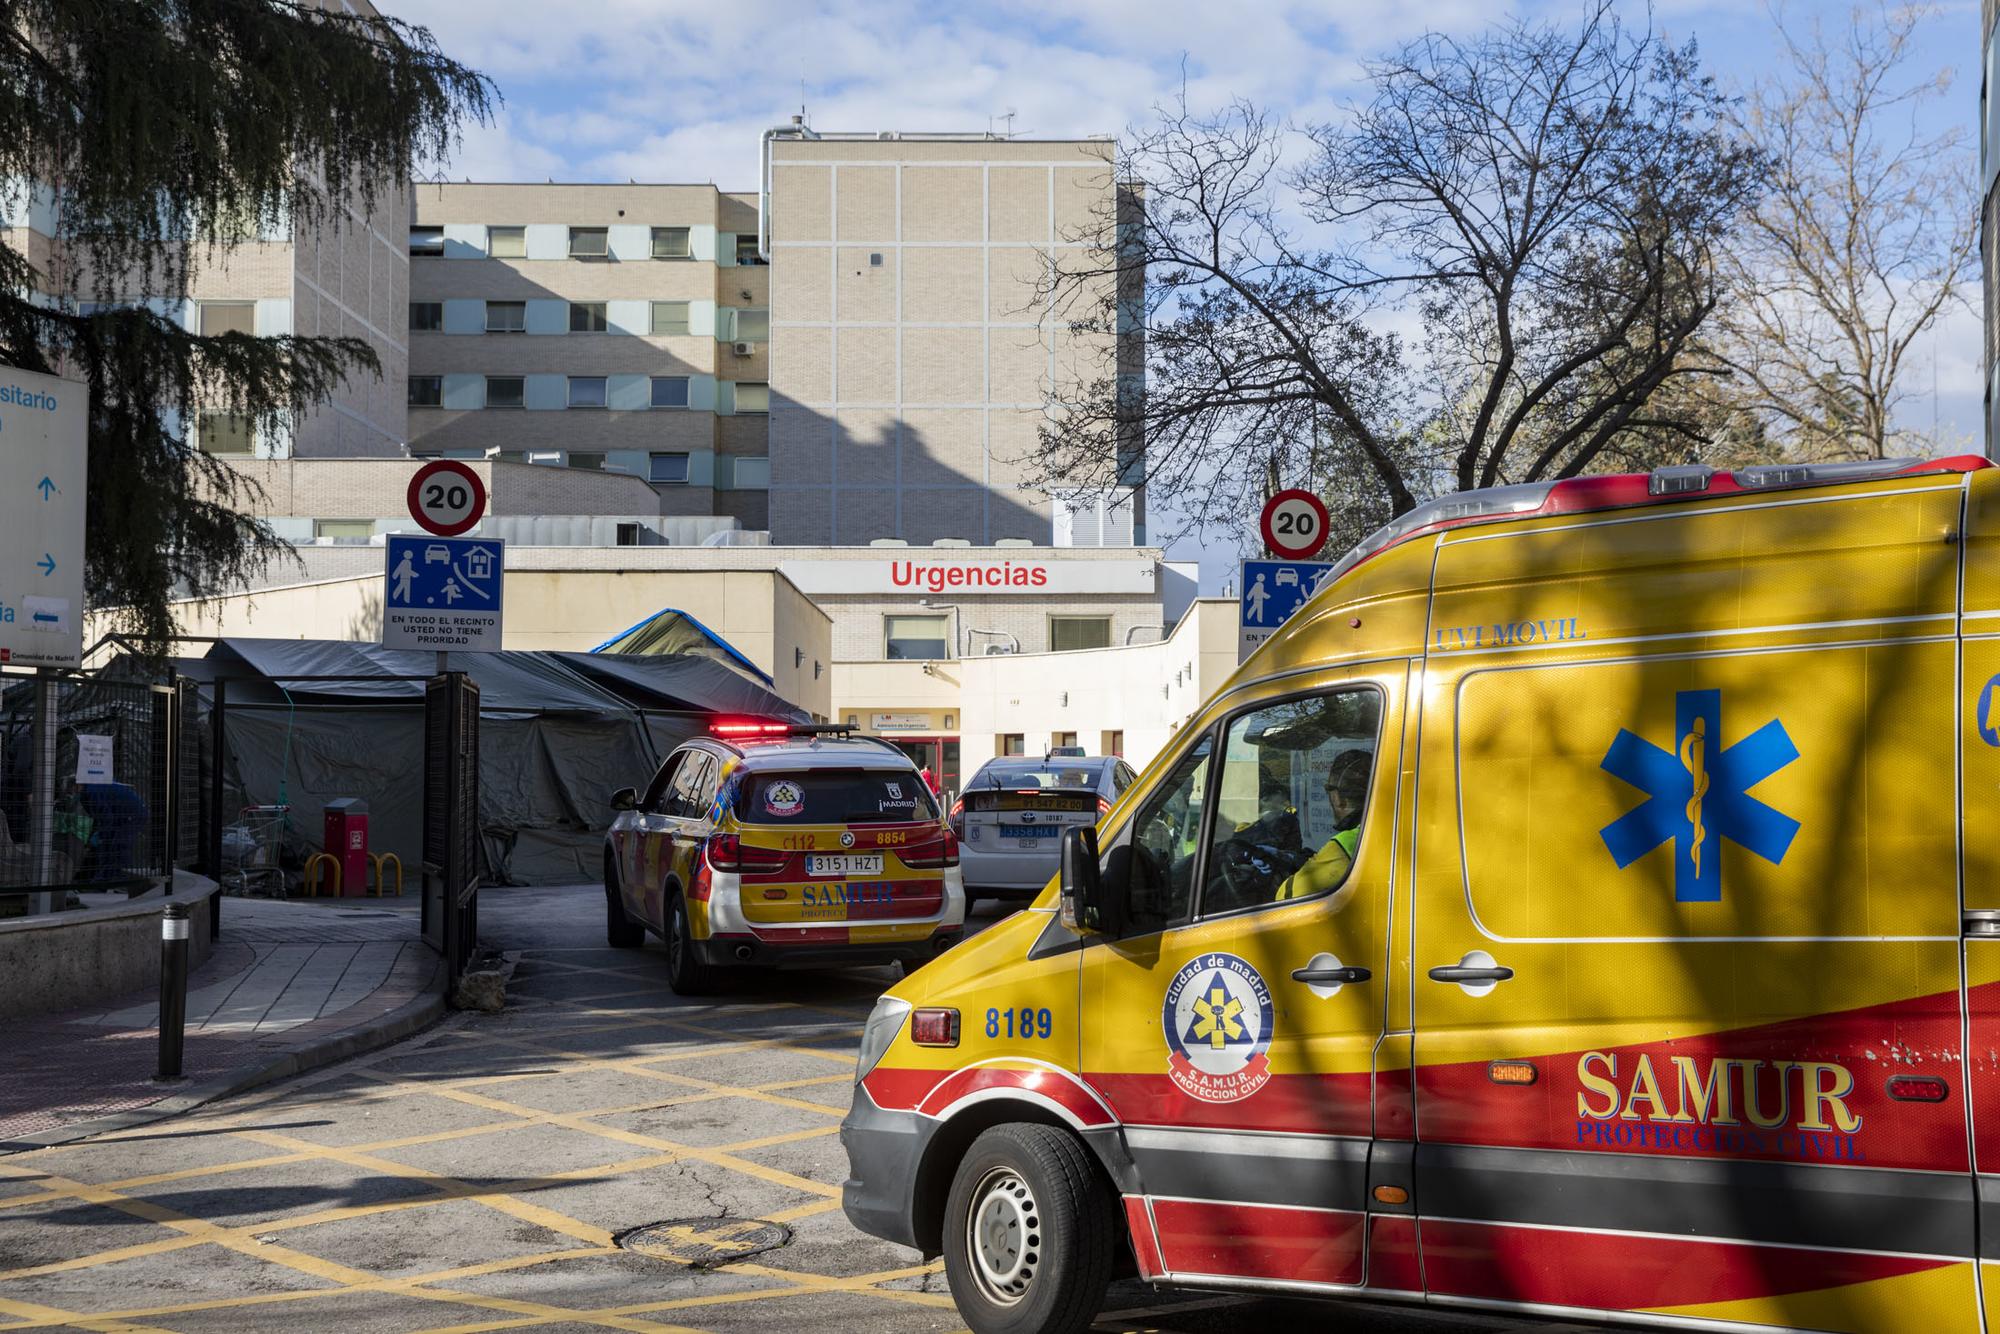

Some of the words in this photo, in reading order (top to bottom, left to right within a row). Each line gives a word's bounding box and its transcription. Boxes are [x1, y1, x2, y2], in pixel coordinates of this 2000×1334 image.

[0, 384, 57, 411] sitario
[426, 485, 468, 510] 20
[1277, 512, 1314, 535] 20
[891, 561, 1048, 593] Urgencias
[391, 615, 405, 624] EN
[408, 615, 436, 625] TODO
[439, 616, 451, 625] EL
[453, 617, 495, 626] RECINTO
[403, 624, 436, 634] USTED
[438, 626, 453, 635] NO
[456, 626, 483, 636] TIENE
[417, 635, 469, 645] PRIORIDAD
[1436, 625, 1483, 650] UVI
[1492, 617, 1587, 646] MOVIL
[12, 651, 45, 661] Comunidad
[792, 833, 815, 849] 112
[876, 832, 906, 844] 8854
[815, 857, 849, 871] 3151
[854, 856, 881, 871] HZT
[802, 881, 895, 907] SAMUR
[1169, 959, 1202, 1005] ciudad
[1207, 954, 1225, 968] de
[1230, 959, 1271, 1006] madrid
[985, 1007, 1052, 1039] 8189
[1174, 1070, 1238, 1099] PROTECCION
[1240, 1074, 1266, 1094] CIVIL
[1188, 1069, 1252, 1088] S.A.M.U.R.
[1577, 1051, 1863, 1133] SAMUR
[1576, 1121, 1766, 1154] PROTECCION
[1776, 1132, 1866, 1161] CIVIL
